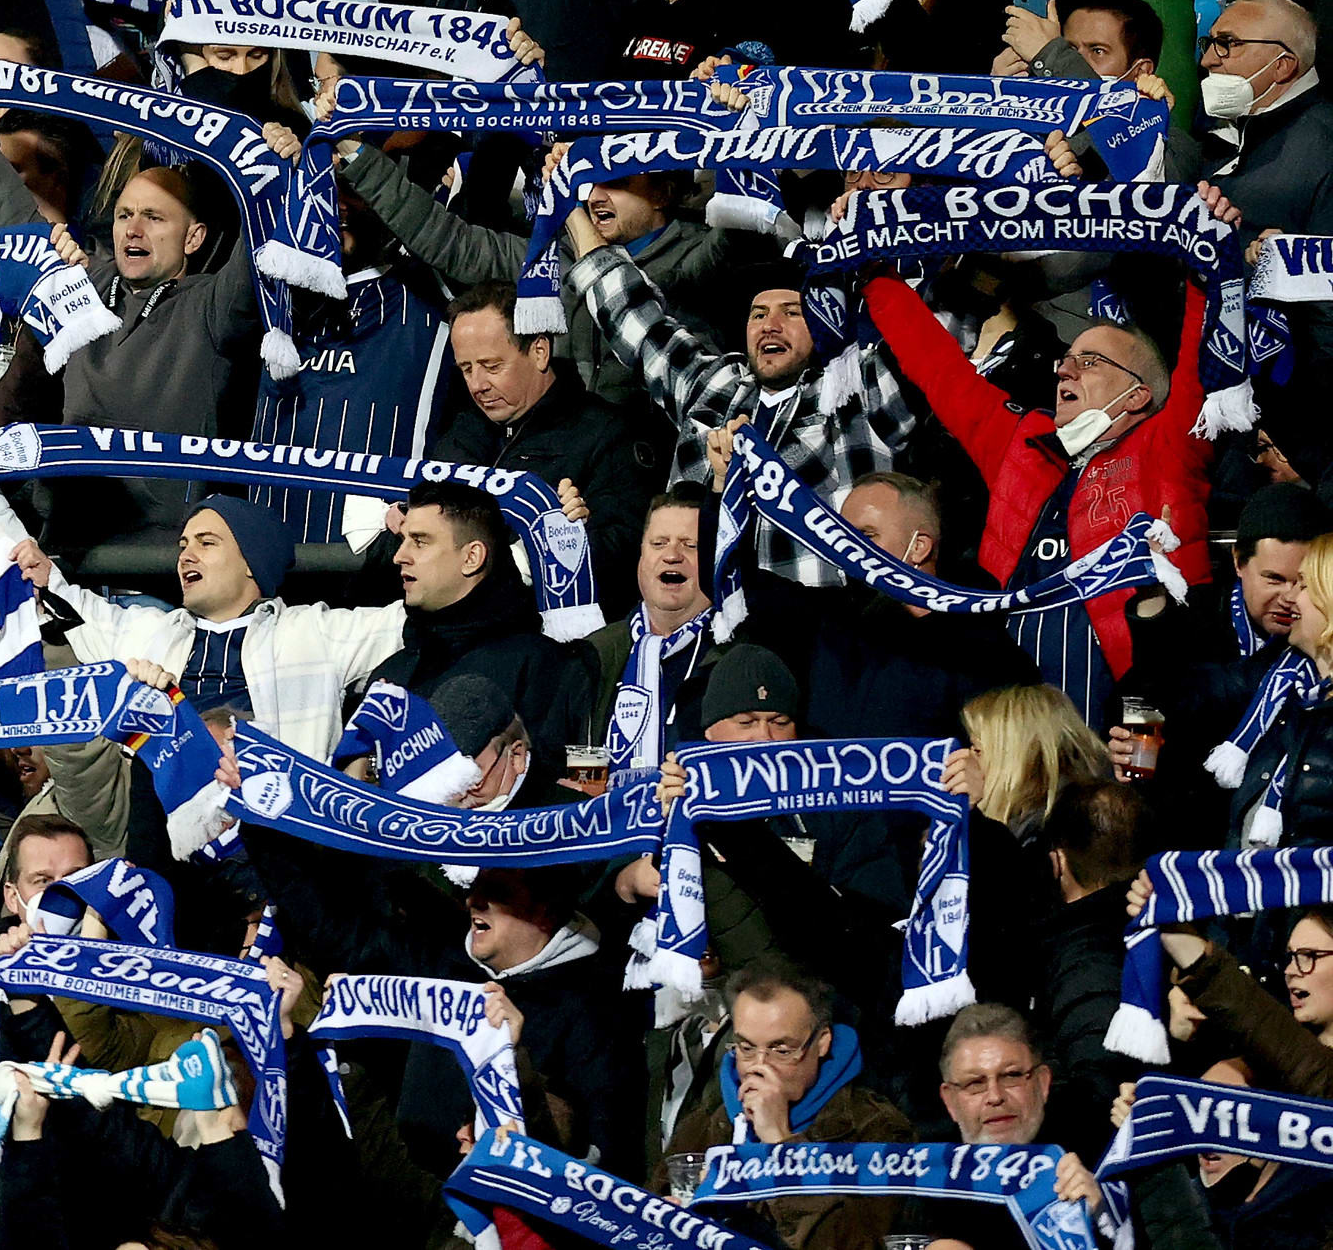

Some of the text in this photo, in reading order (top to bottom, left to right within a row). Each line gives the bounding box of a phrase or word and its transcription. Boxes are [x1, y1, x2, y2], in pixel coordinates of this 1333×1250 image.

[214, 19, 457, 65] FUSSBALLGEMEINSCHAFT e.V.
[426, 11, 511, 62] 1848
[71, 76, 233, 148] Bochum
[397, 115, 431, 129] DES
[474, 114, 553, 128] BOCHUM
[558, 113, 602, 127] 1848
[1128, 113, 1164, 139] Bochum
[842, 182, 1233, 240] VfL BOCHUM
[815, 219, 1045, 264] DIE MACHT VOM
[49, 276, 91, 307] Bochum
[64, 295, 91, 316] 1848
[548, 523, 584, 540] Bochum
[17, 675, 102, 726] VfL
[385, 724, 445, 779] BOCHUM
[732, 738, 955, 796] BOCHUM
[379, 794, 612, 847] BOCHUM
[777, 790, 884, 808] MEIN VEREIN
[7, 970, 58, 988] EINMAL
[187, 953, 253, 976] SEIT 1848
[323, 974, 486, 1037] BOCHUM 1848
[1174, 1094, 1262, 1144] VfL
[712, 1143, 1058, 1191] Tradition seit 1848
[564, 1160, 734, 1250] BOCHUM
